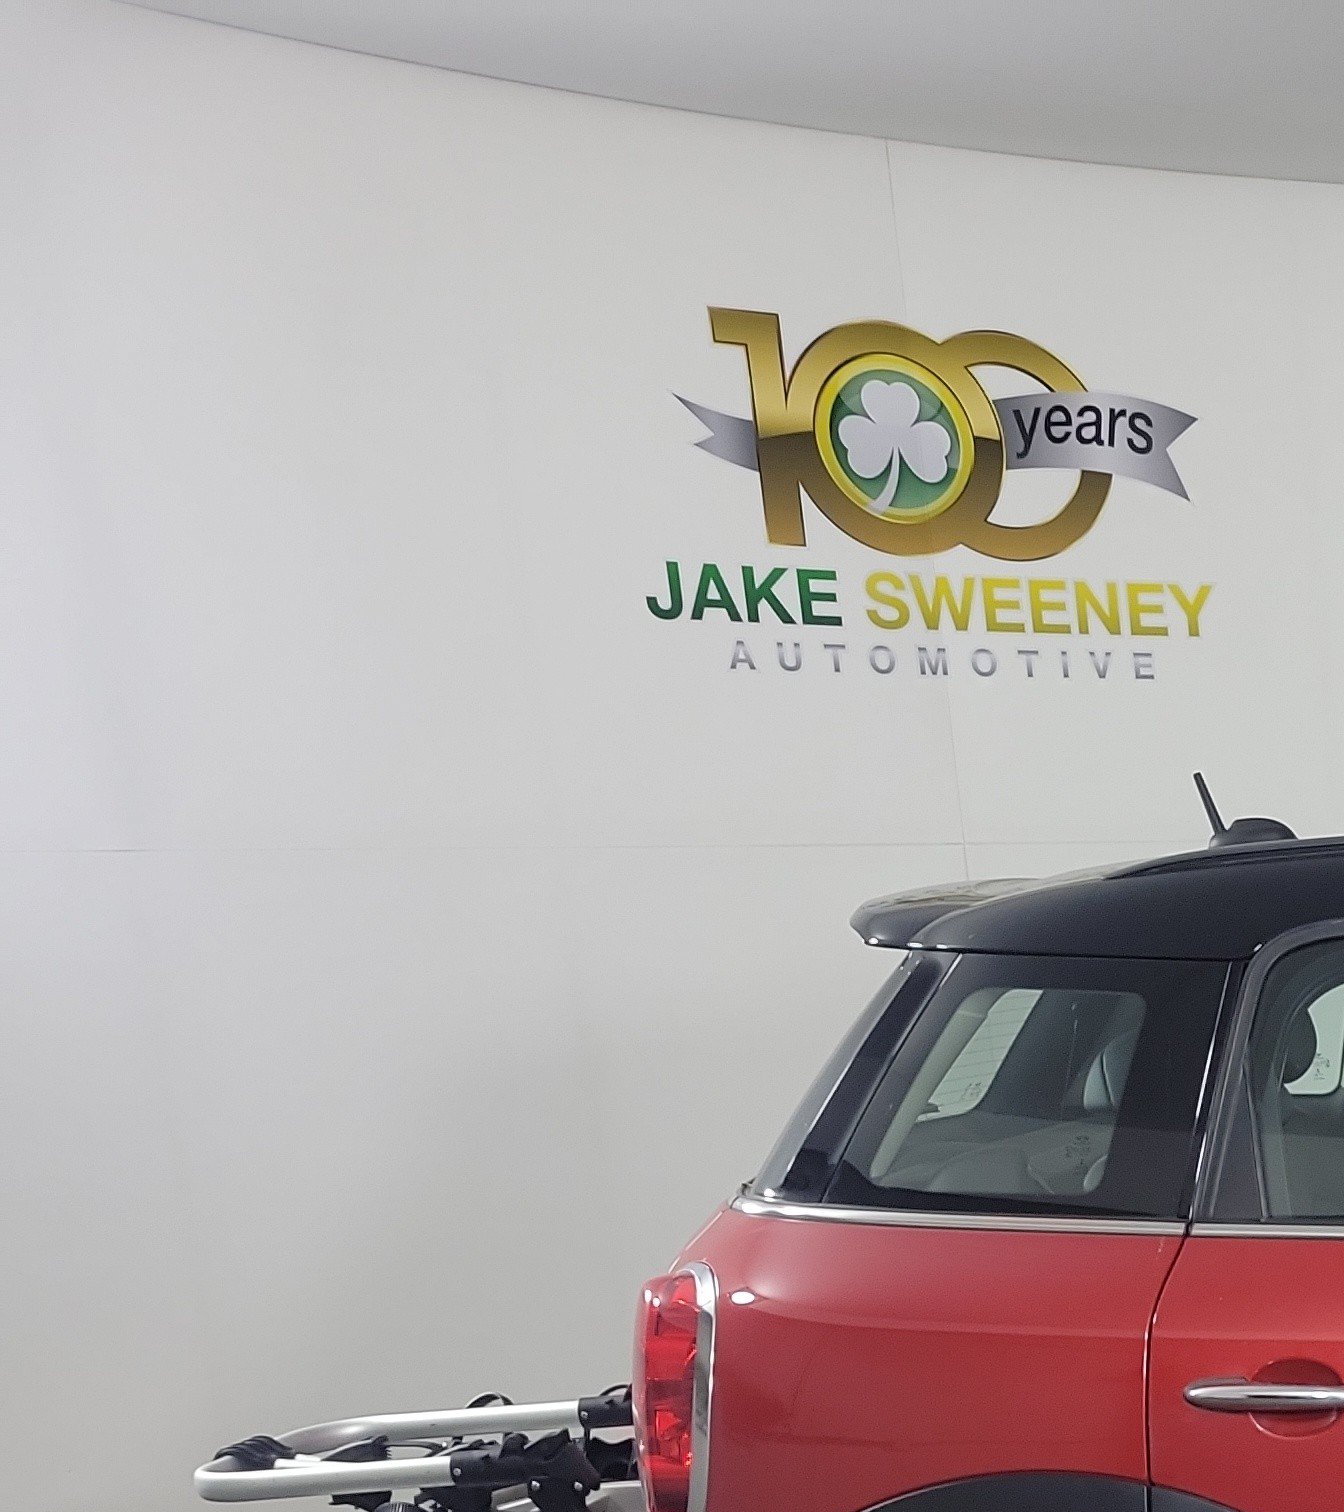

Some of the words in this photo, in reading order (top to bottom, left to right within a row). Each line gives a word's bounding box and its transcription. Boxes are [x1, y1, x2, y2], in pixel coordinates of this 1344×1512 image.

[1013, 403, 1155, 459] years
[646, 561, 843, 627] JAKE
[865, 571, 1213, 638] SWEENEY
[729, 640, 1156, 680] AUTOMOTIVE
